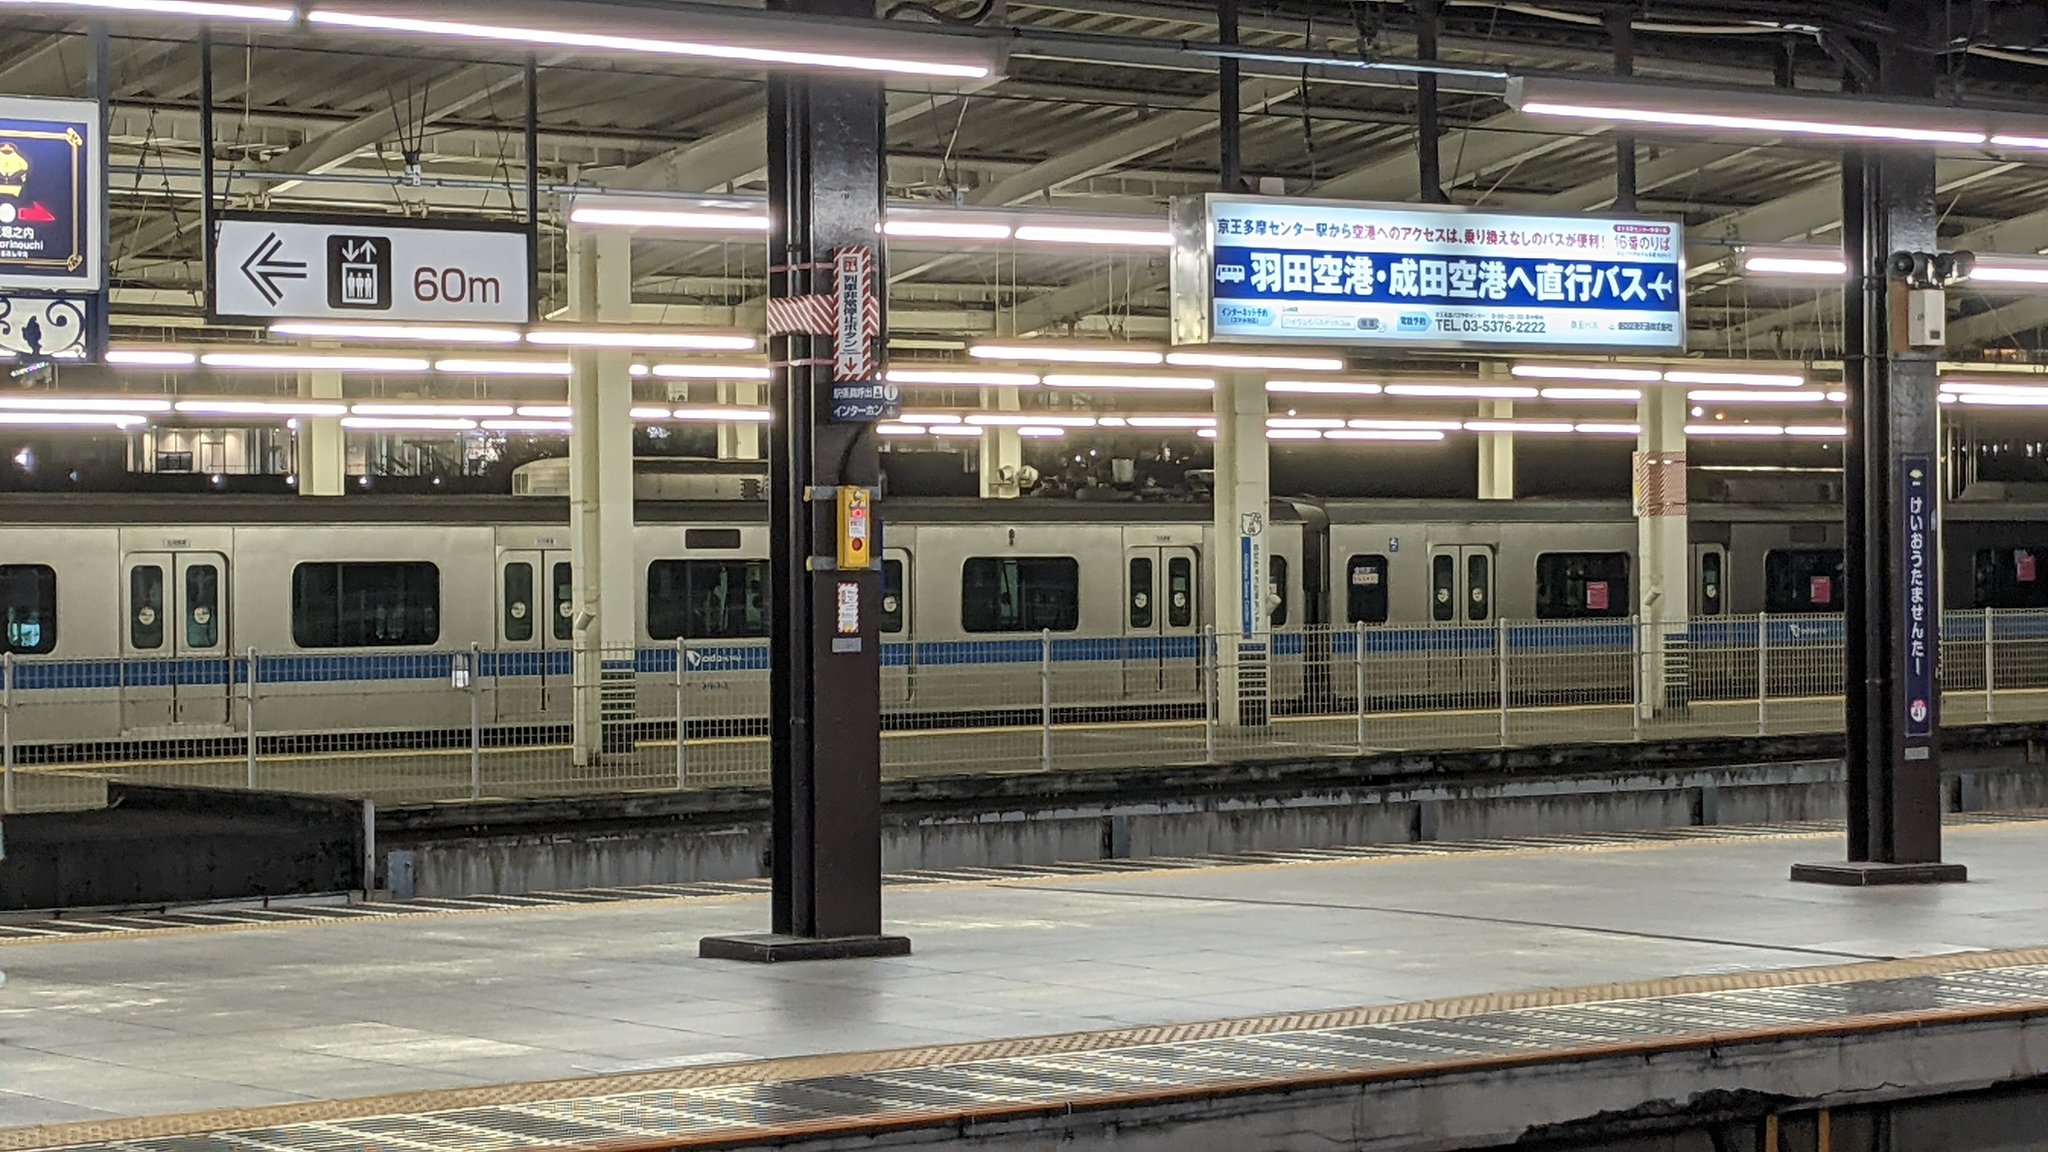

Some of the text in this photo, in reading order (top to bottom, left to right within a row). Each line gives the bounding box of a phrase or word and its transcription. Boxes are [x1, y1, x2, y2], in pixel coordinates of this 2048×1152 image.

[1614, 234, 1671, 251] 16番のりば
[413, 266, 501, 304] 60m
[1250, 252, 1647, 302] 羽田空港・成田空港へ直行バス
[1436, 319, 1546, 333] TEL. 03-5376-2222
[833, 404, 884, 417] インターホン
[1910, 496, 1924, 675] けいおうたませんたー
